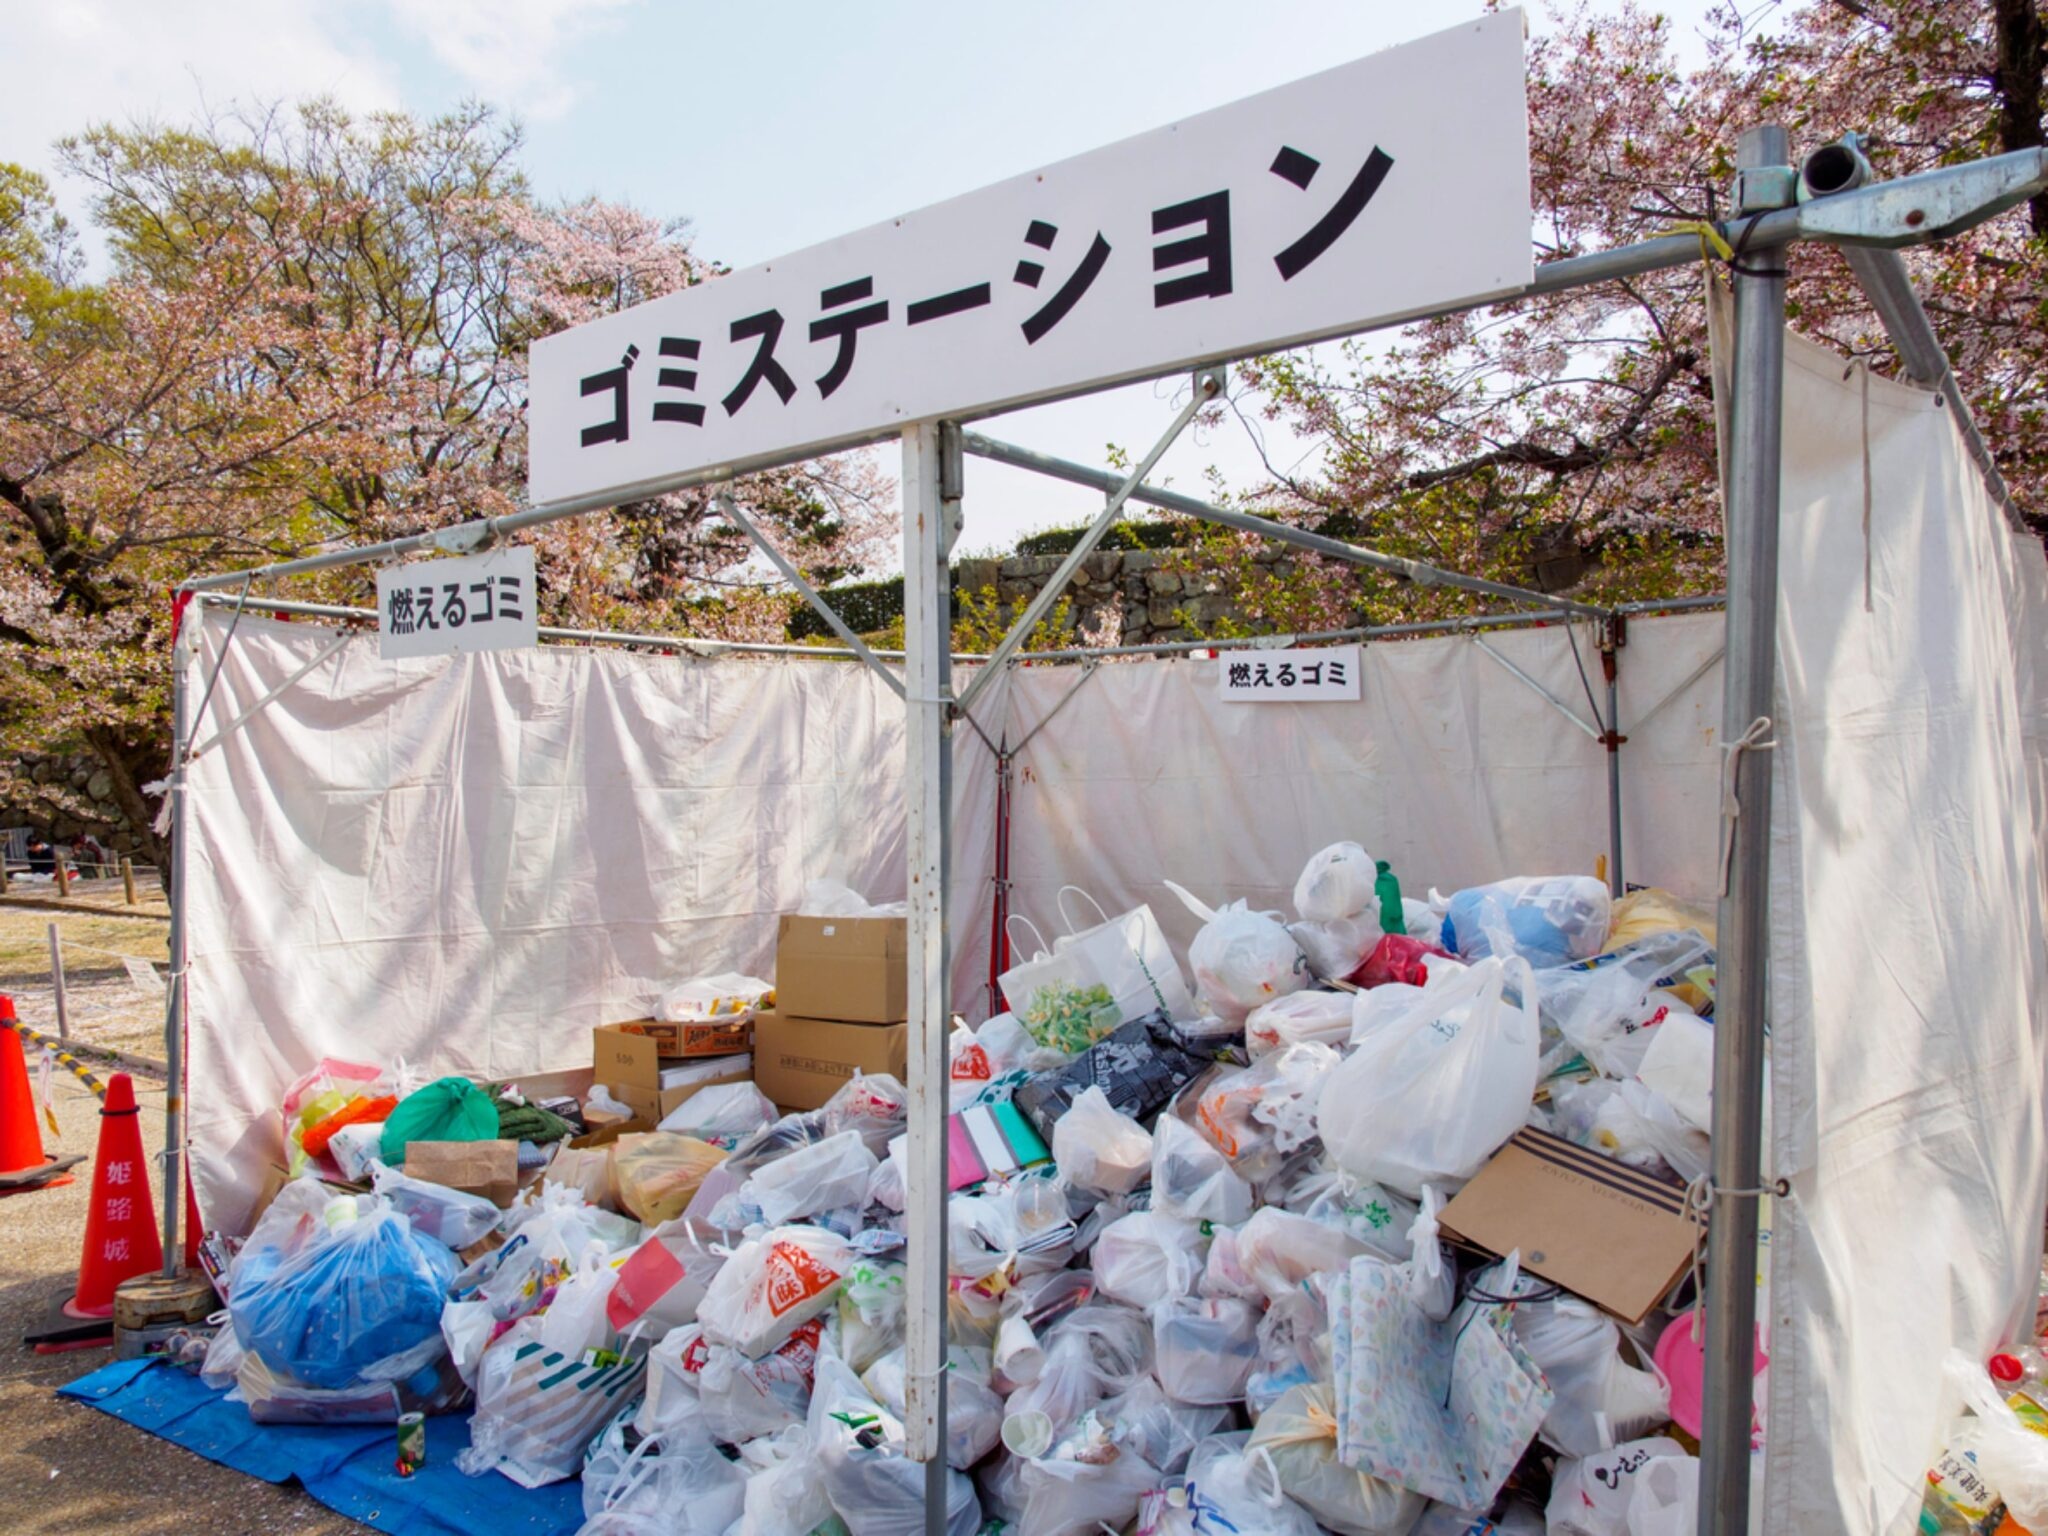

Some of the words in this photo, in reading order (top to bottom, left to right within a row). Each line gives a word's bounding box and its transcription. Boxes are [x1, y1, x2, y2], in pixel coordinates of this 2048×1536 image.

[579, 145, 1395, 448] ゴミステーション
[388, 575, 523, 635] 燃えるゴミ
[1228, 661, 1347, 688] 燃えるゴミ
[104, 1161, 132, 1261] 姫路城
